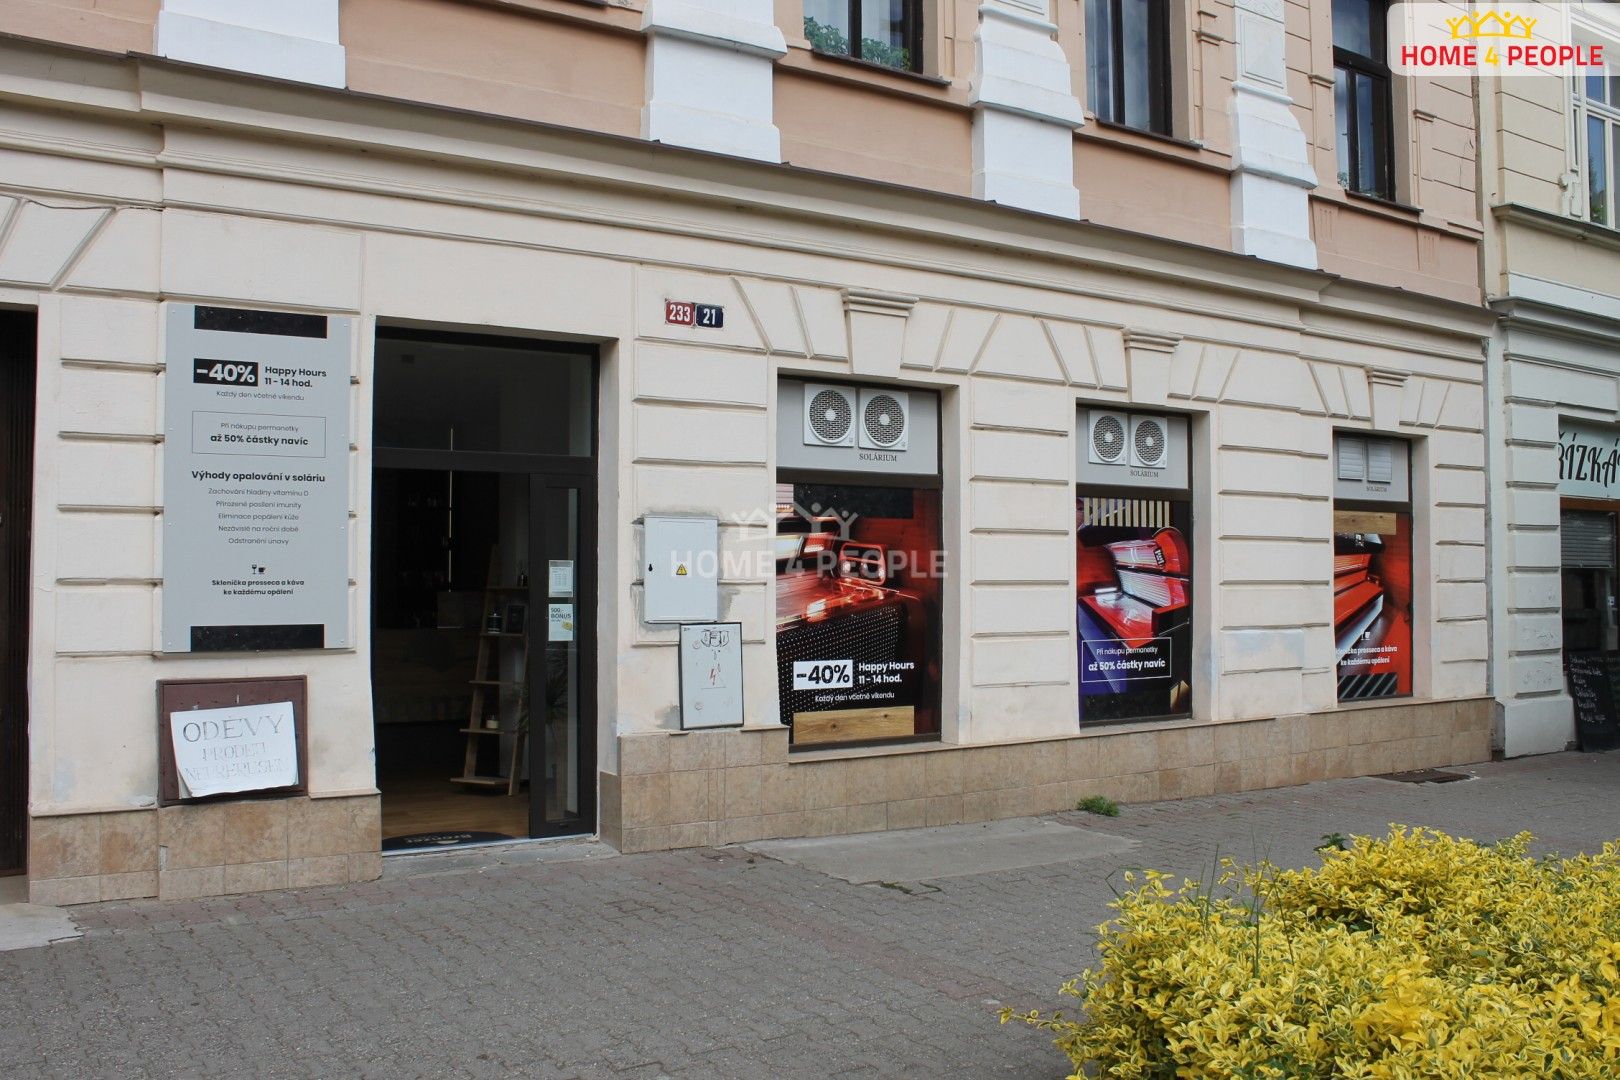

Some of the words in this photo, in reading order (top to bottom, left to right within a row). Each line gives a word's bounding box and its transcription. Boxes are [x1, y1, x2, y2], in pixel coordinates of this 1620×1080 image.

[669, 304, 691, 322] 233
[703, 308, 716, 325] 21
[196, 363, 256, 383] -40%
[264, 366, 297, 378] Happy
[298, 368, 327, 378] Hours
[264, 377, 272, 385] 11
[280, 378, 290, 386] 14
[292, 379, 313, 388] hod.
[216, 390, 238, 399] Každý
[253, 392, 277, 400] včetně
[278, 393, 305, 401] víkendu
[230, 423, 257, 431] nákupu
[210, 433, 222, 443] až
[224, 435, 244, 443] 50%
[246, 435, 280, 446] částky
[281, 436, 309, 446] navíc
[858, 452, 898, 462] SOLÁRIUM
[1558, 431, 1620, 489] ŘÍZKÁ
[191, 470, 231, 481] Výhody
[232, 472, 283, 482] opalování
[292, 473, 326, 482] soláriu
[1129, 468, 1159, 478] SOLÁRIUM
[208, 487, 246, 496] Zachování
[246, 488, 272, 497] hladiny
[215, 500, 248, 508] Přirozené
[276, 501, 302, 509] imunity
[252, 513, 283, 521] popálení
[280, 525, 299, 533] době
[228, 537, 267, 545] Odstranění
[267, 589, 294, 597] opálení
[1104, 647, 1125, 656] nákupu
[858, 662, 889, 674] Happy
[889, 661, 915, 671] Hours
[1088, 662, 1098, 672] až
[1099, 661, 1116, 671] 50%
[1116, 659, 1144, 672] částky
[1143, 657, 1166, 668] navíc
[796, 664, 851, 685] -40%
[858, 675, 865, 684] 11
[872, 675, 882, 684] 14
[883, 673, 903, 683] hod.
[815, 693, 834, 703] Každý
[834, 693, 848, 701] den
[848, 692, 871, 701] včetně
[871, 691, 895, 700] víkendu
